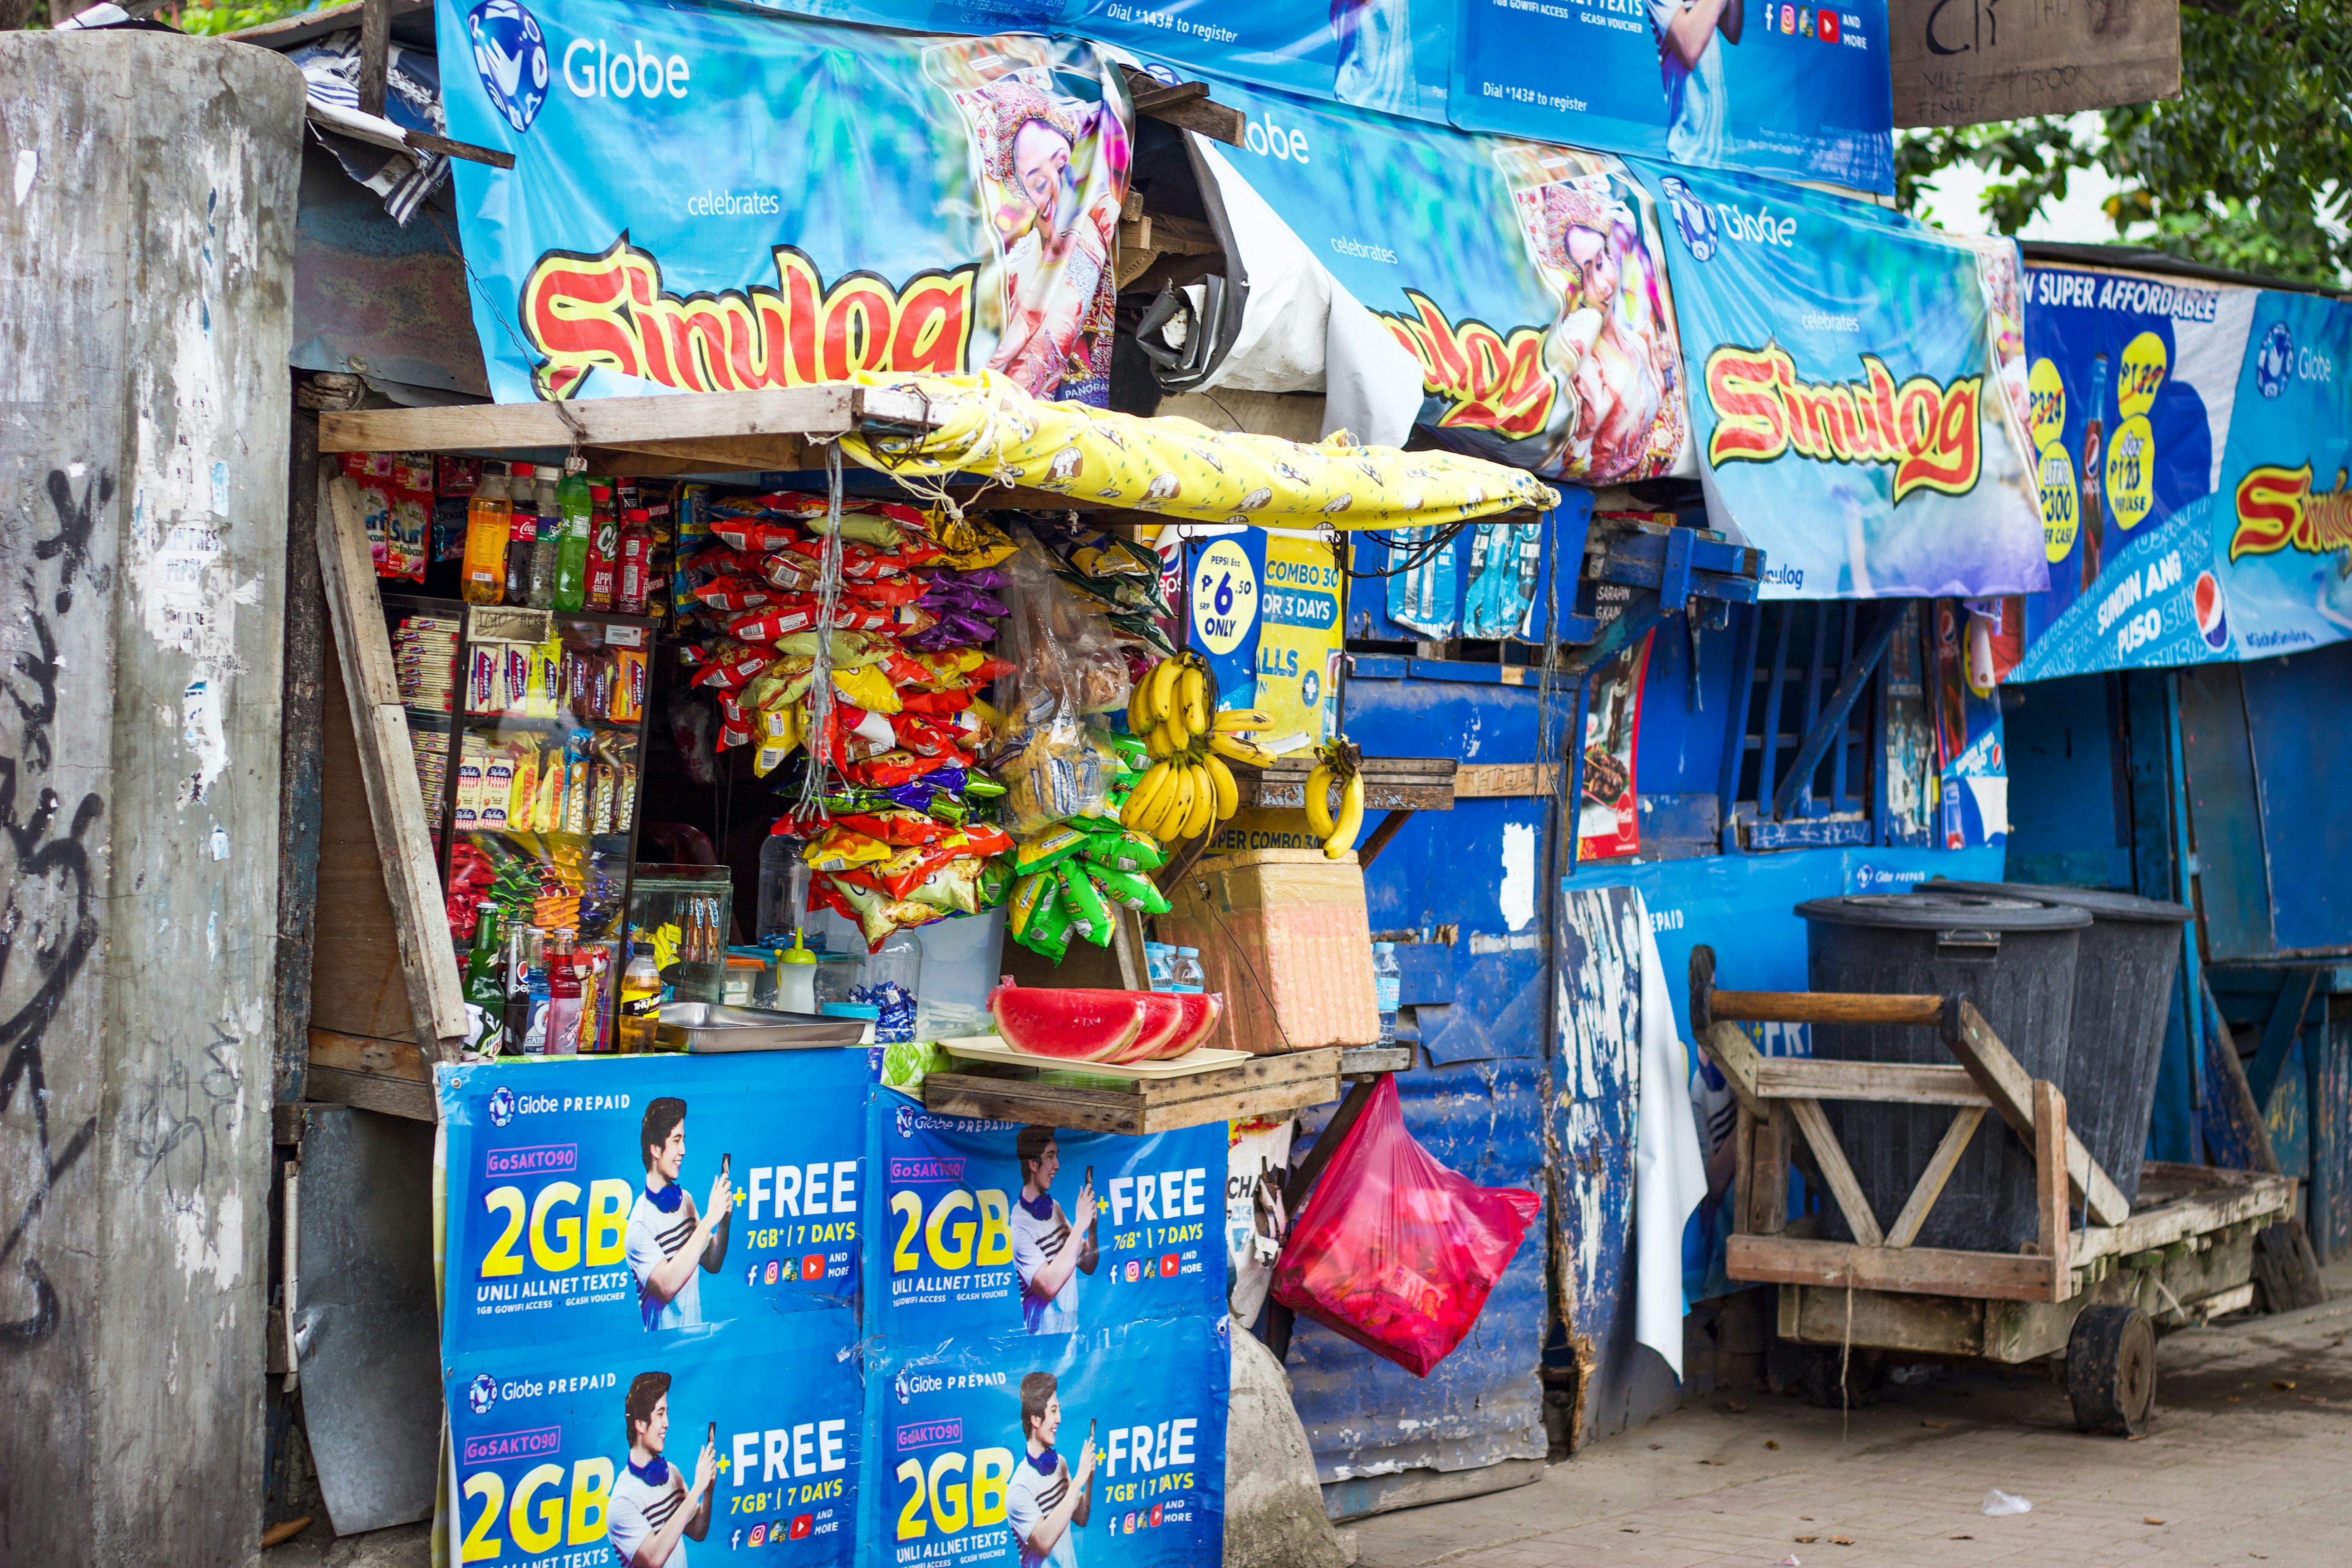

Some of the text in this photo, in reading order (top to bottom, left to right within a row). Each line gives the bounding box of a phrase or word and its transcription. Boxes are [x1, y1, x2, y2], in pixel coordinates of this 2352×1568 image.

[1107, 3, 1131, 22] Dial
[1177, 18, 1189, 33] to
[1193, 24, 1238, 44] register
[1541, 5, 1568, 19] ACCESS
[1581, 12, 1643, 33] GCASH VOUCHER
[1842, 15, 1861, 29] AND
[1843, 33, 1867, 50] MORE
[564, 38, 690, 99] Globe
[1483, 82, 1502, 98] Dial
[1537, 92, 1547, 106] to
[1550, 93, 1588, 113] register
[1244, 113, 1310, 164] obe
[688, 190, 779, 216] celebrates
[1716, 203, 1797, 248] Globe
[1331, 234, 1398, 265] celebrates
[2040, 277, 2095, 309] SUPER
[2098, 279, 2217, 322] AFFORDABLE
[1802, 311, 1859, 333] celebrates
[2298, 346, 2332, 382] Globe
[1065, 383, 1109, 400] PANORA
[1705, 332, 1985, 509] Sinulog
[2043, 458, 2069, 487] LITRO
[648, 503, 670, 517] KOPIKO
[2044, 527, 2073, 544] ER CASE
[1211, 555, 1240, 568] PEPSI 8oz
[647, 578, 665, 591] KOPIKO
[1265, 559, 1339, 588] COMBO 30
[593, 584, 609, 593] GREEN
[2097, 549, 2182, 636] SUNDIN ANG
[1199, 602, 1210, 611] SRP
[1263, 595, 1330, 620] OR 3 DAYS
[1205, 617, 1237, 637] ONLY
[2117, 608, 2161, 662] PUSO
[515, 656, 527, 697] Magic
[547, 663, 557, 699] Magic
[567, 798, 577, 833] BARR
[573, 782, 583, 835] FUDGEE
[1210, 829, 1321, 850] PER COMBO 30
[1895, 871, 1926, 882] PREPAID
[1649, 910, 1684, 933] EPAID
[518, 1093, 631, 1115] Globe PREPAID
[914, 1115, 1014, 1133] Globe PREPAID
[489, 1148, 575, 1172] GoSAKTO90
[482, 1178, 634, 1278] 2GB
[797, 1225, 806, 1243] 7
[811, 1221, 856, 1243] DAYS
[890, 1188, 1013, 1273] 2GB
[1158, 1228, 1166, 1245] 7
[1168, 1222, 1203, 1244] DAYS
[828, 1252, 848, 1263] AND
[1181, 1250, 1197, 1261] AND
[828, 1265, 850, 1278] MORE
[1181, 1262, 1203, 1274] MORE
[477, 1272, 628, 1302] UNLI ALLNET TEXTS
[916, 1275, 970, 1293] ALLNET
[974, 1272, 1011, 1288] TEXTS
[476, 1292, 625, 1315] 1GB GOWIFI ACCESS GCASH VOUCHER
[919, 1294, 946, 1304] ACCESS
[956, 1292, 980, 1302] GCASH
[981, 1289, 1009, 1300] VOUCHER
[501, 1372, 617, 1401] Globe PREPAID
[910, 1371, 1007, 1394] Globe PREPAID
[467, 1433, 557, 1458] GoSAKTO90
[788, 1488, 798, 1507] 7
[800, 1478, 843, 1504] DAYS
[896, 1446, 1015, 1541] 2GB
[1149, 1480, 1156, 1495] 7
[1158, 1471, 1195, 1494] DAYS
[461, 1456, 615, 1563] 2GB
[816, 1508, 833, 1520] AND
[1164, 1499, 1185, 1510] AND
[814, 1522, 838, 1535] MORE
[1163, 1512, 1192, 1524] MORE
[563, 1547, 609, 1568] TEXTS
[897, 1530, 1008, 1563] UNLI ALLNET TEXTS
[926, 1559, 951, 1568] ACCESS
[960, 1553, 977, 1564] GCASH
[978, 1548, 1006, 1560] VOUCHER
